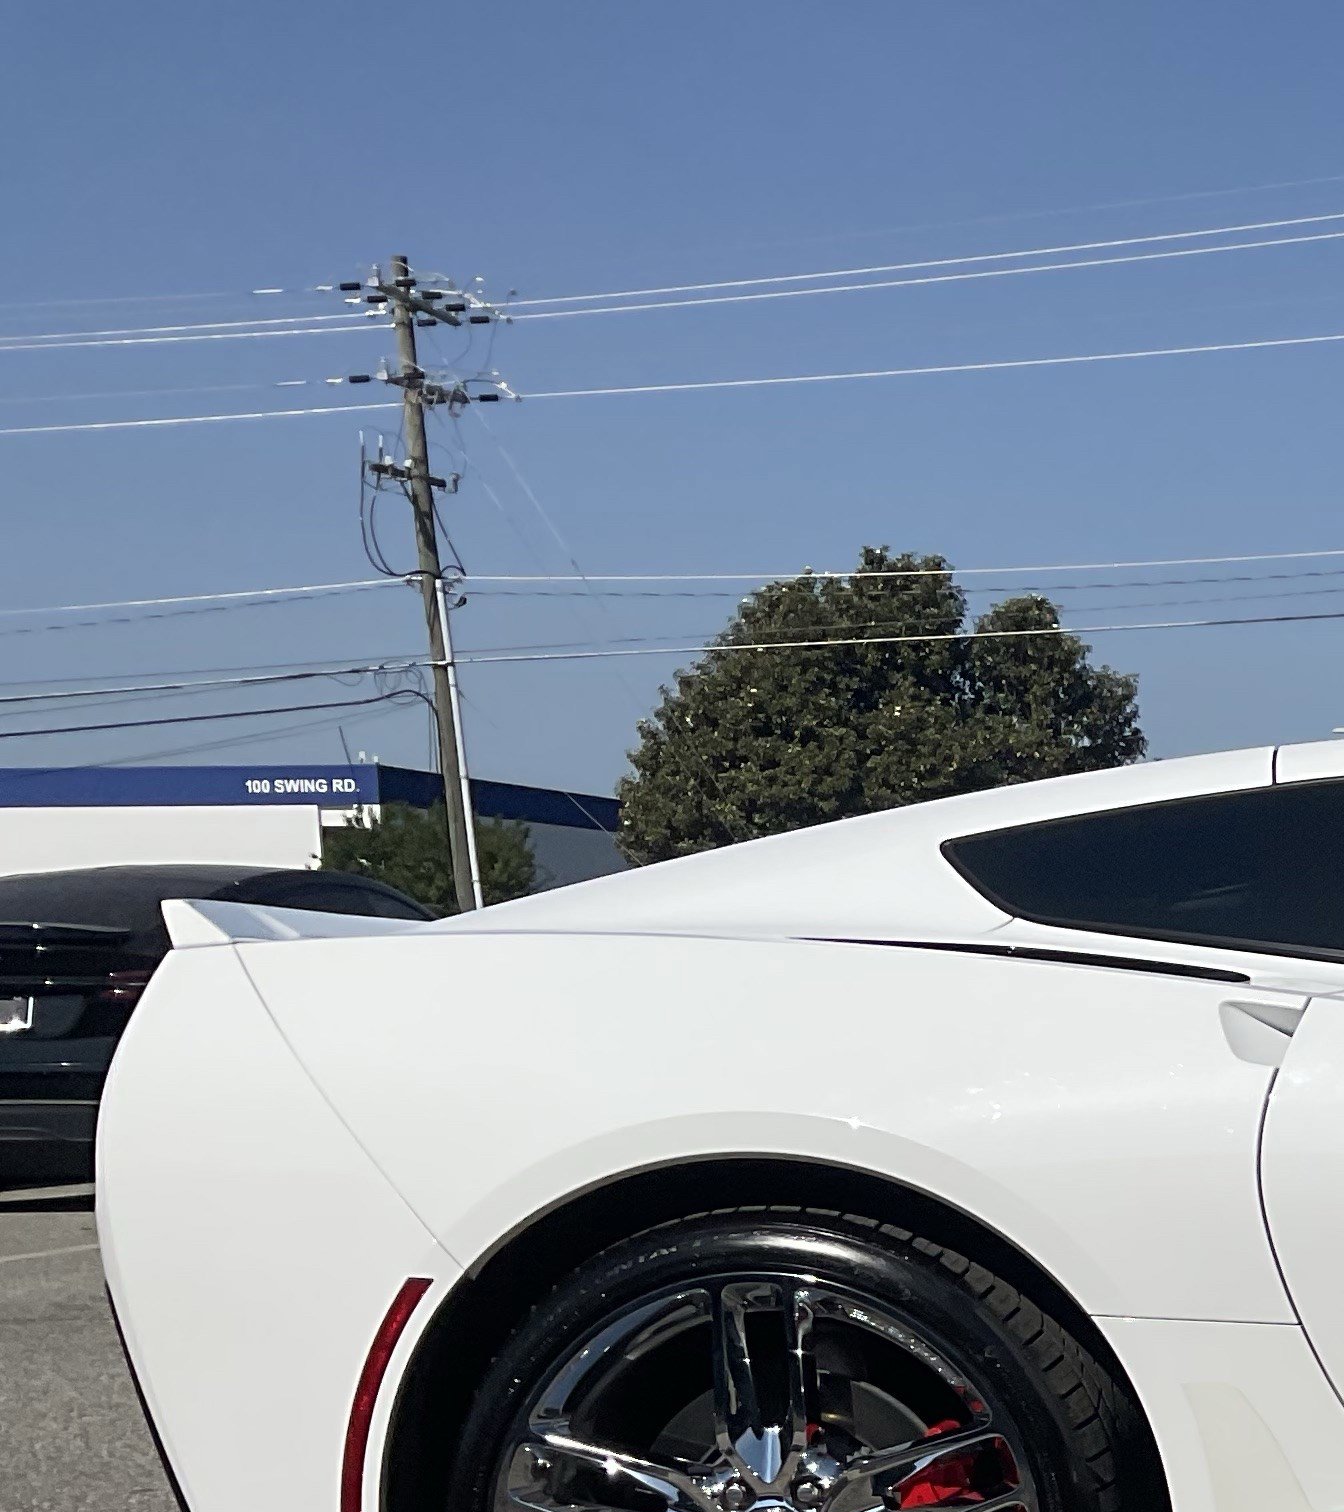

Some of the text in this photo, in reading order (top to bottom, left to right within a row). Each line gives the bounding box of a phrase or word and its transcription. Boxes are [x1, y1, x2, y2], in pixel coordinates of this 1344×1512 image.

[245, 778, 360, 794] 100 SWING RD.
